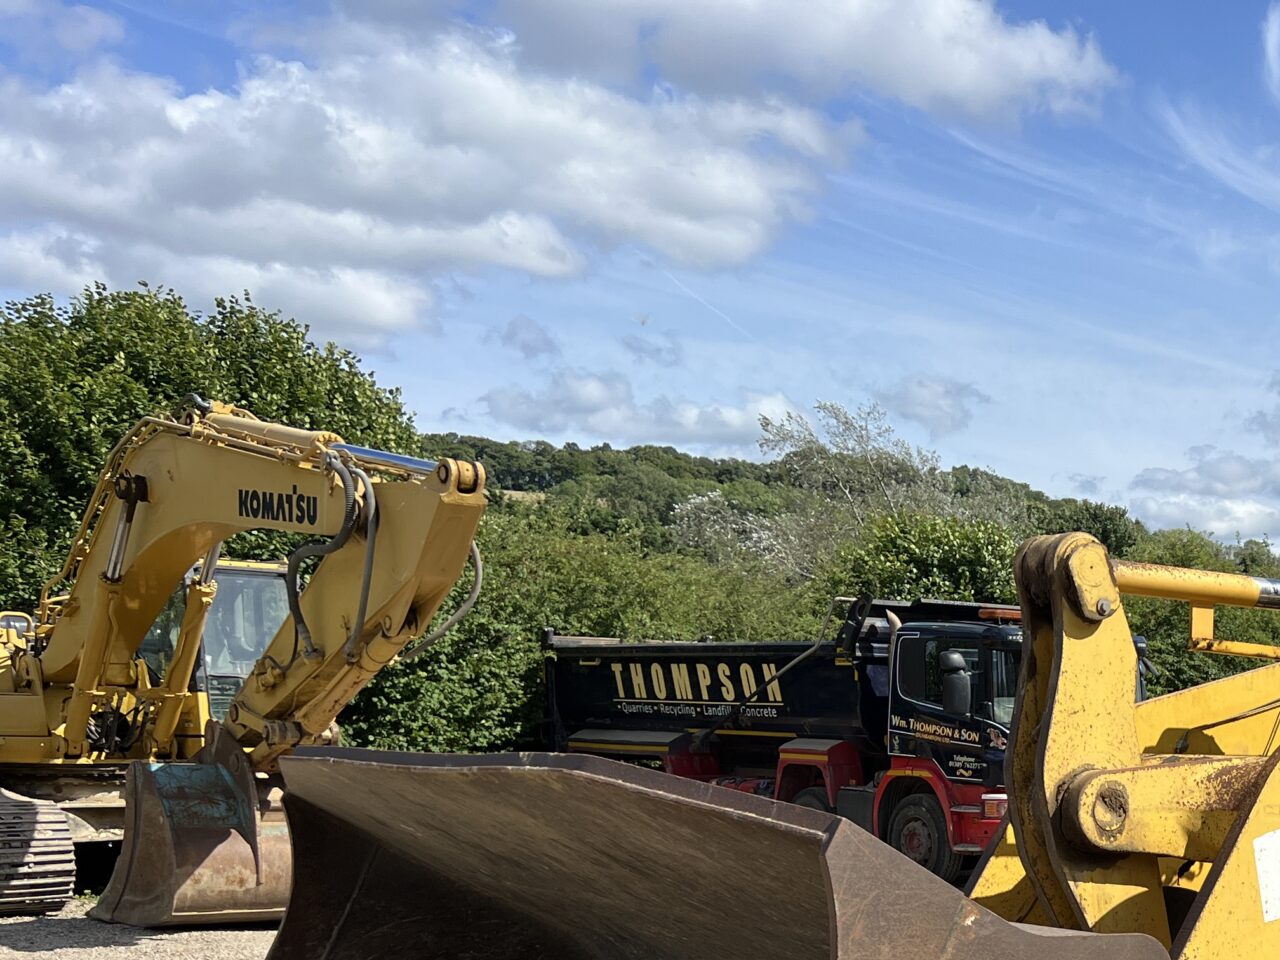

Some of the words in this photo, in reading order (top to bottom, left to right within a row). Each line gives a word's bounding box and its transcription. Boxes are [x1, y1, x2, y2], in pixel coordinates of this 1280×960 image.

[238, 484, 318, 526] KOMATSU
[611, 662, 783, 702] THOMPSON
[622, 702, 653, 714] Quarries
[660, 703, 696, 717] Recycling
[740, 706, 777, 718] Concrete
[909, 718, 953, 738] THOMPSON
[953, 729, 960, 739] &
[960, 728, 980, 743] SON
